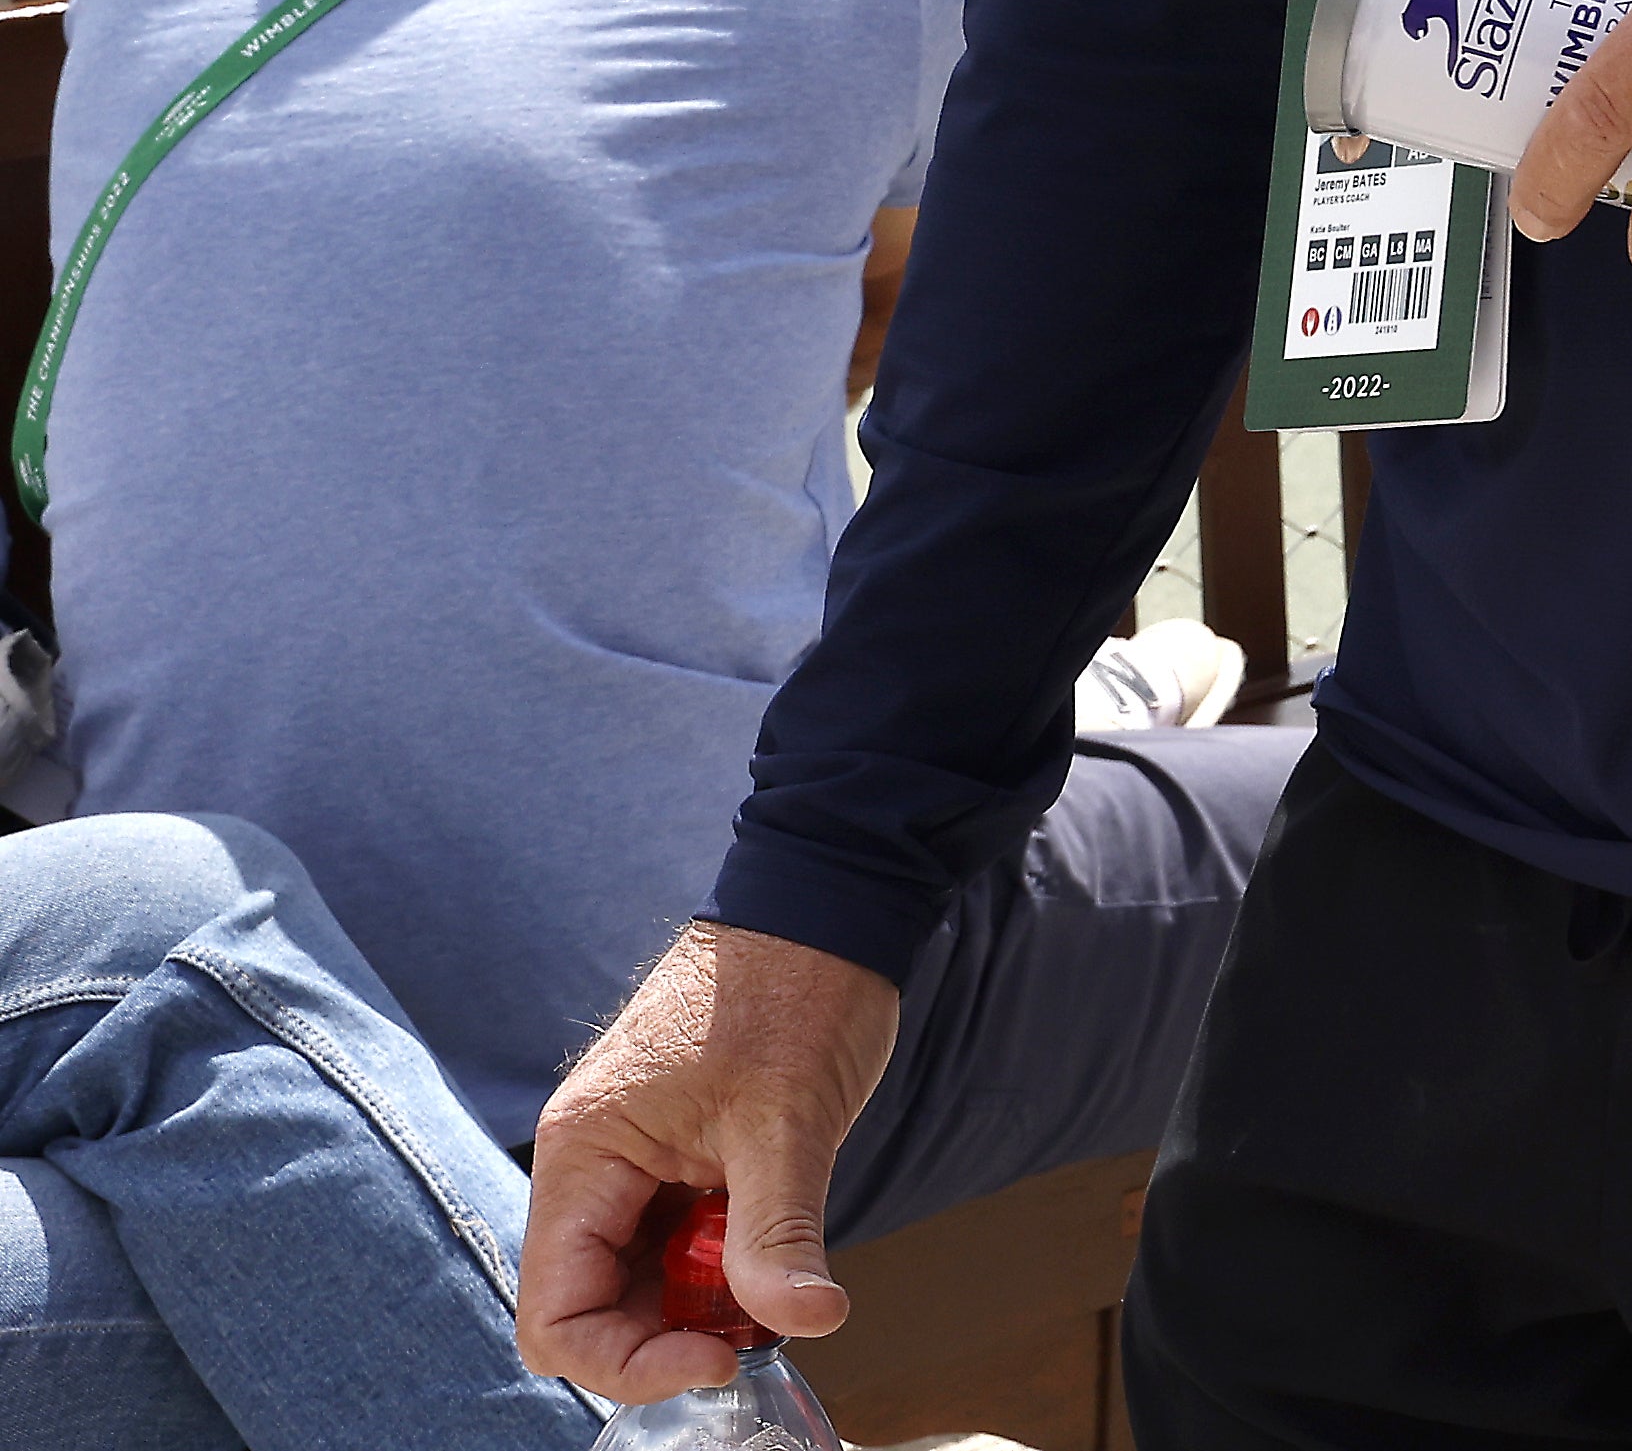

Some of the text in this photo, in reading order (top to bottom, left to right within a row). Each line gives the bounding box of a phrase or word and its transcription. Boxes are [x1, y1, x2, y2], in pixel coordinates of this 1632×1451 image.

[1314, 172, 1388, 193] Jeremy BATES
[1312, 192, 1371, 207] PLAYER'S COACH
[1309, 222, 1351, 234] Katie Boulter
[1308, 237, 1433, 264] BC CM GA L8 MA
[27, 384, 44, 422] THE
[39, 222, 103, 382] CHAMPIONSHIPS
[100, 170, 131, 220] 2022
